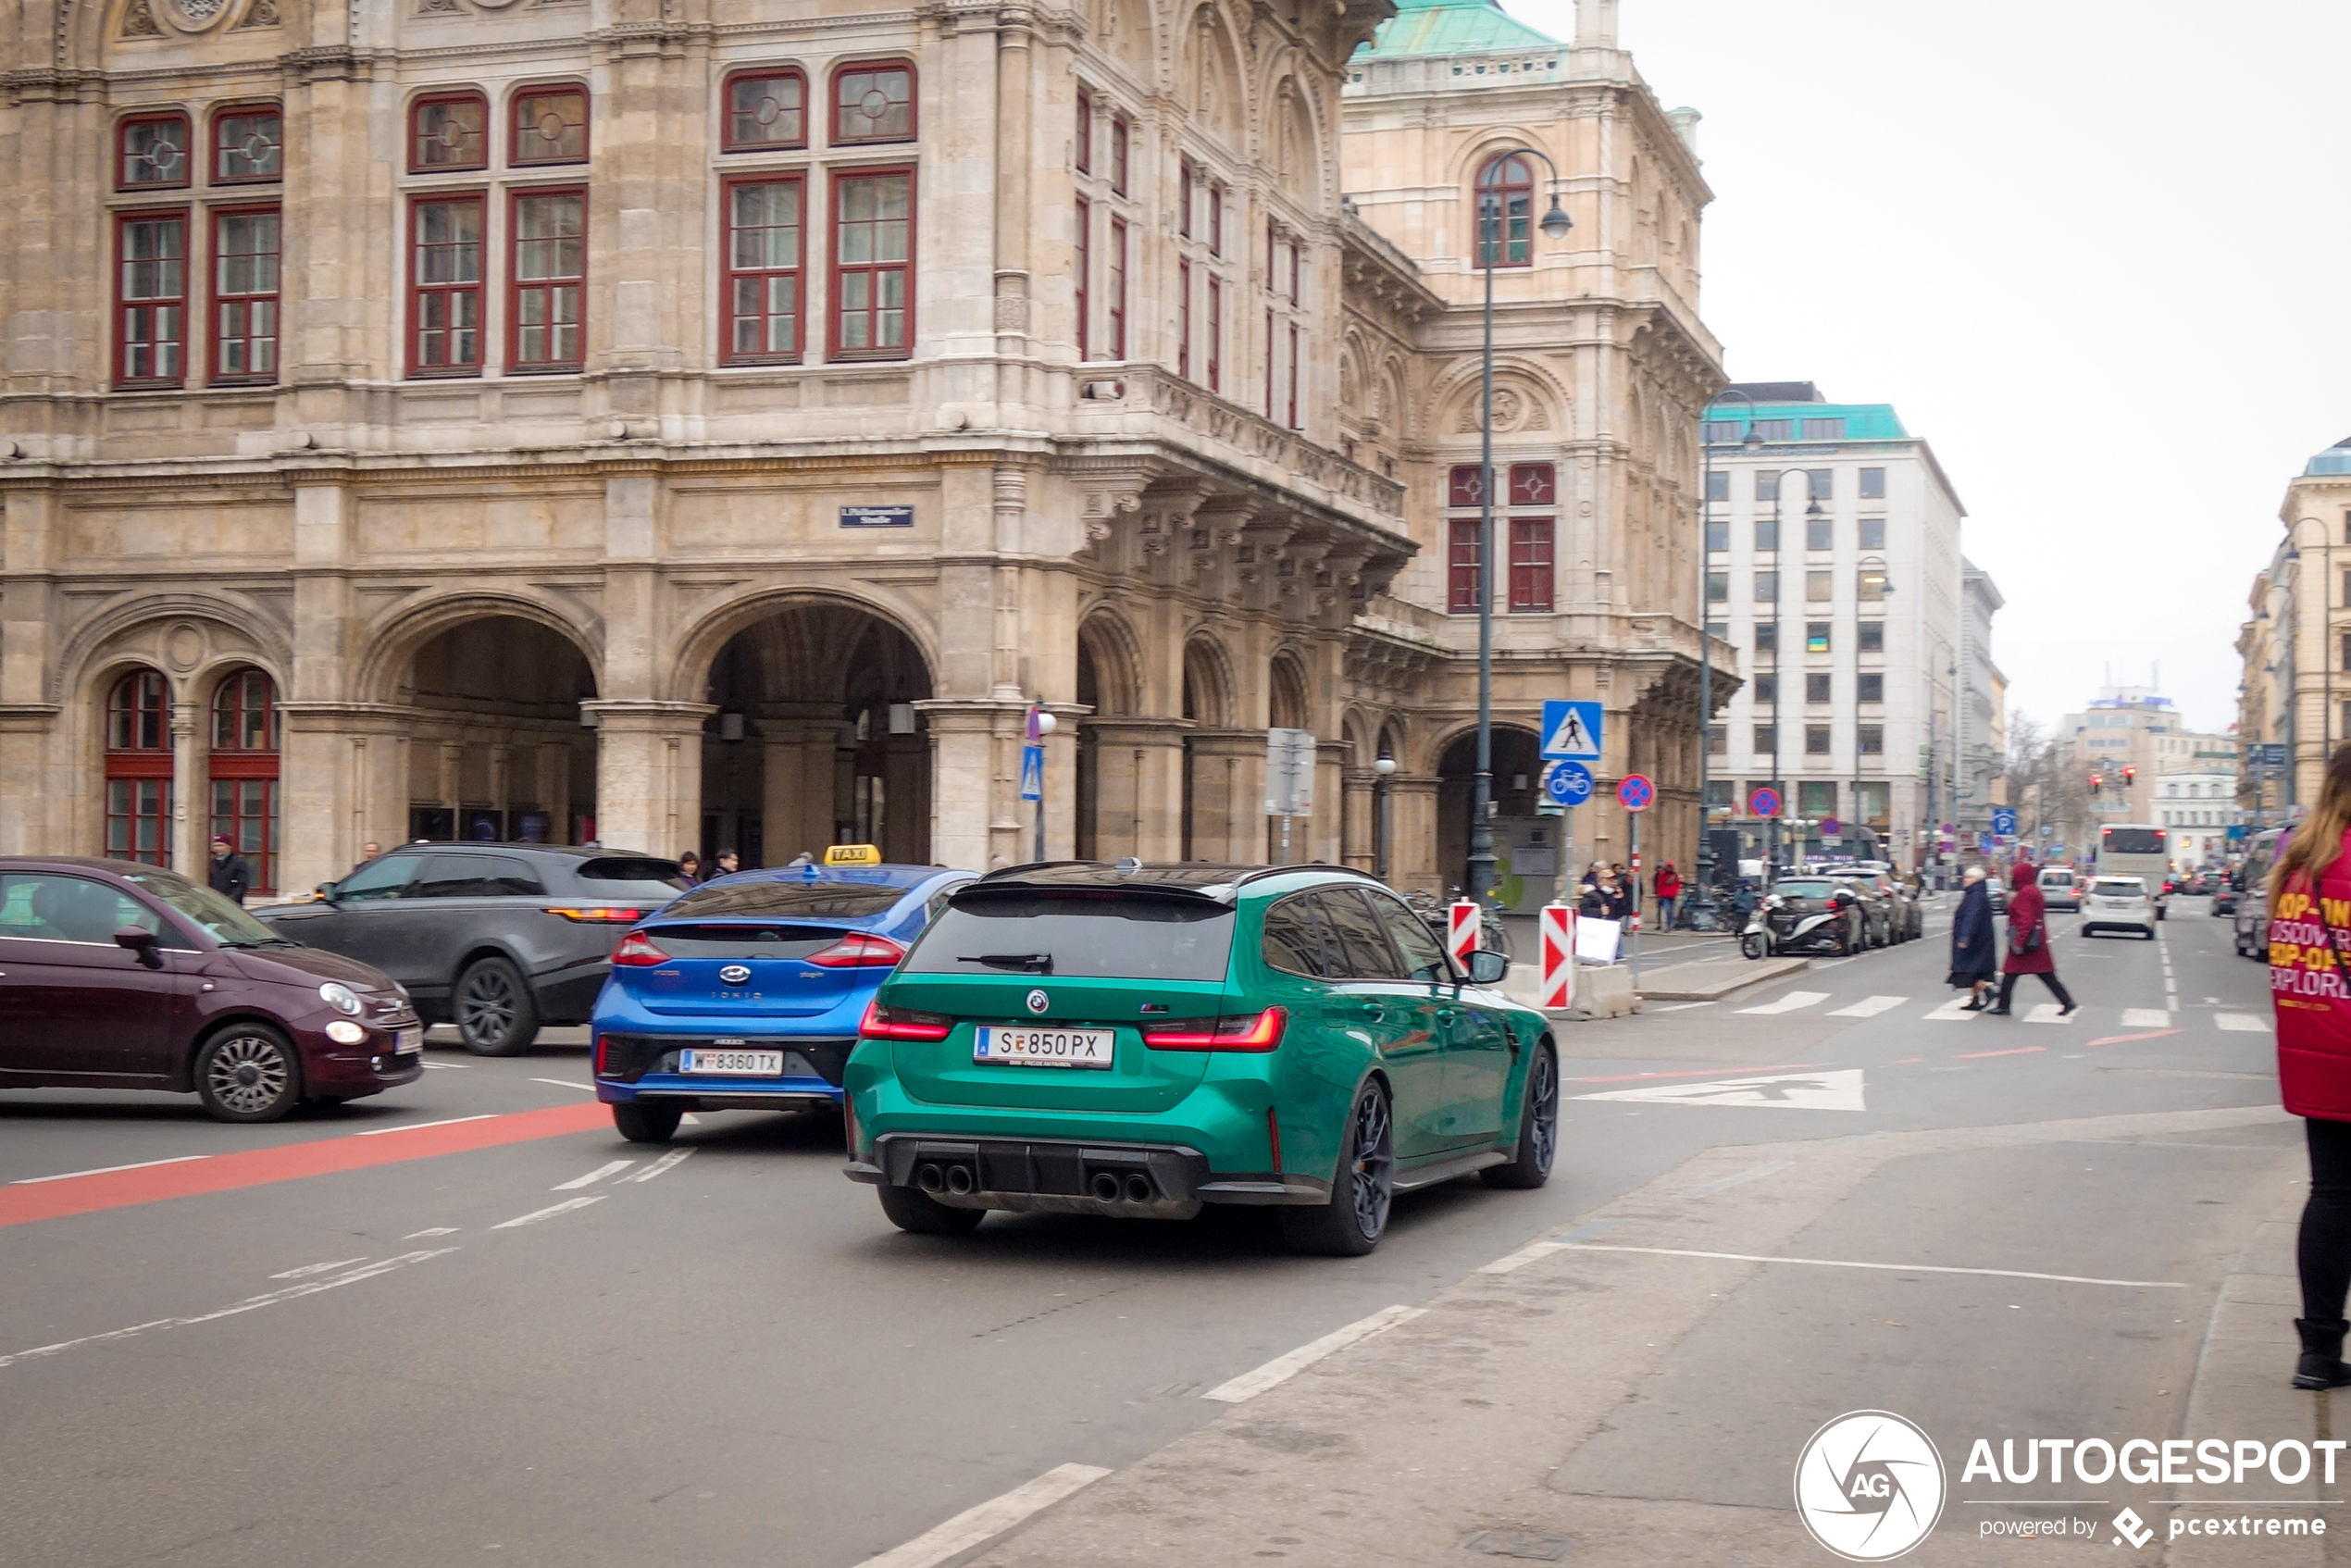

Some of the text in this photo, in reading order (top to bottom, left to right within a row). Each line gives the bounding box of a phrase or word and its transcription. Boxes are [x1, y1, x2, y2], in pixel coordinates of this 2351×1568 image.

[834, 849, 866, 860] TAXI
[1001, 1032, 1012, 1053] S
[694, 1053, 704, 1068] W
[716, 1053, 754, 1070] 8360
